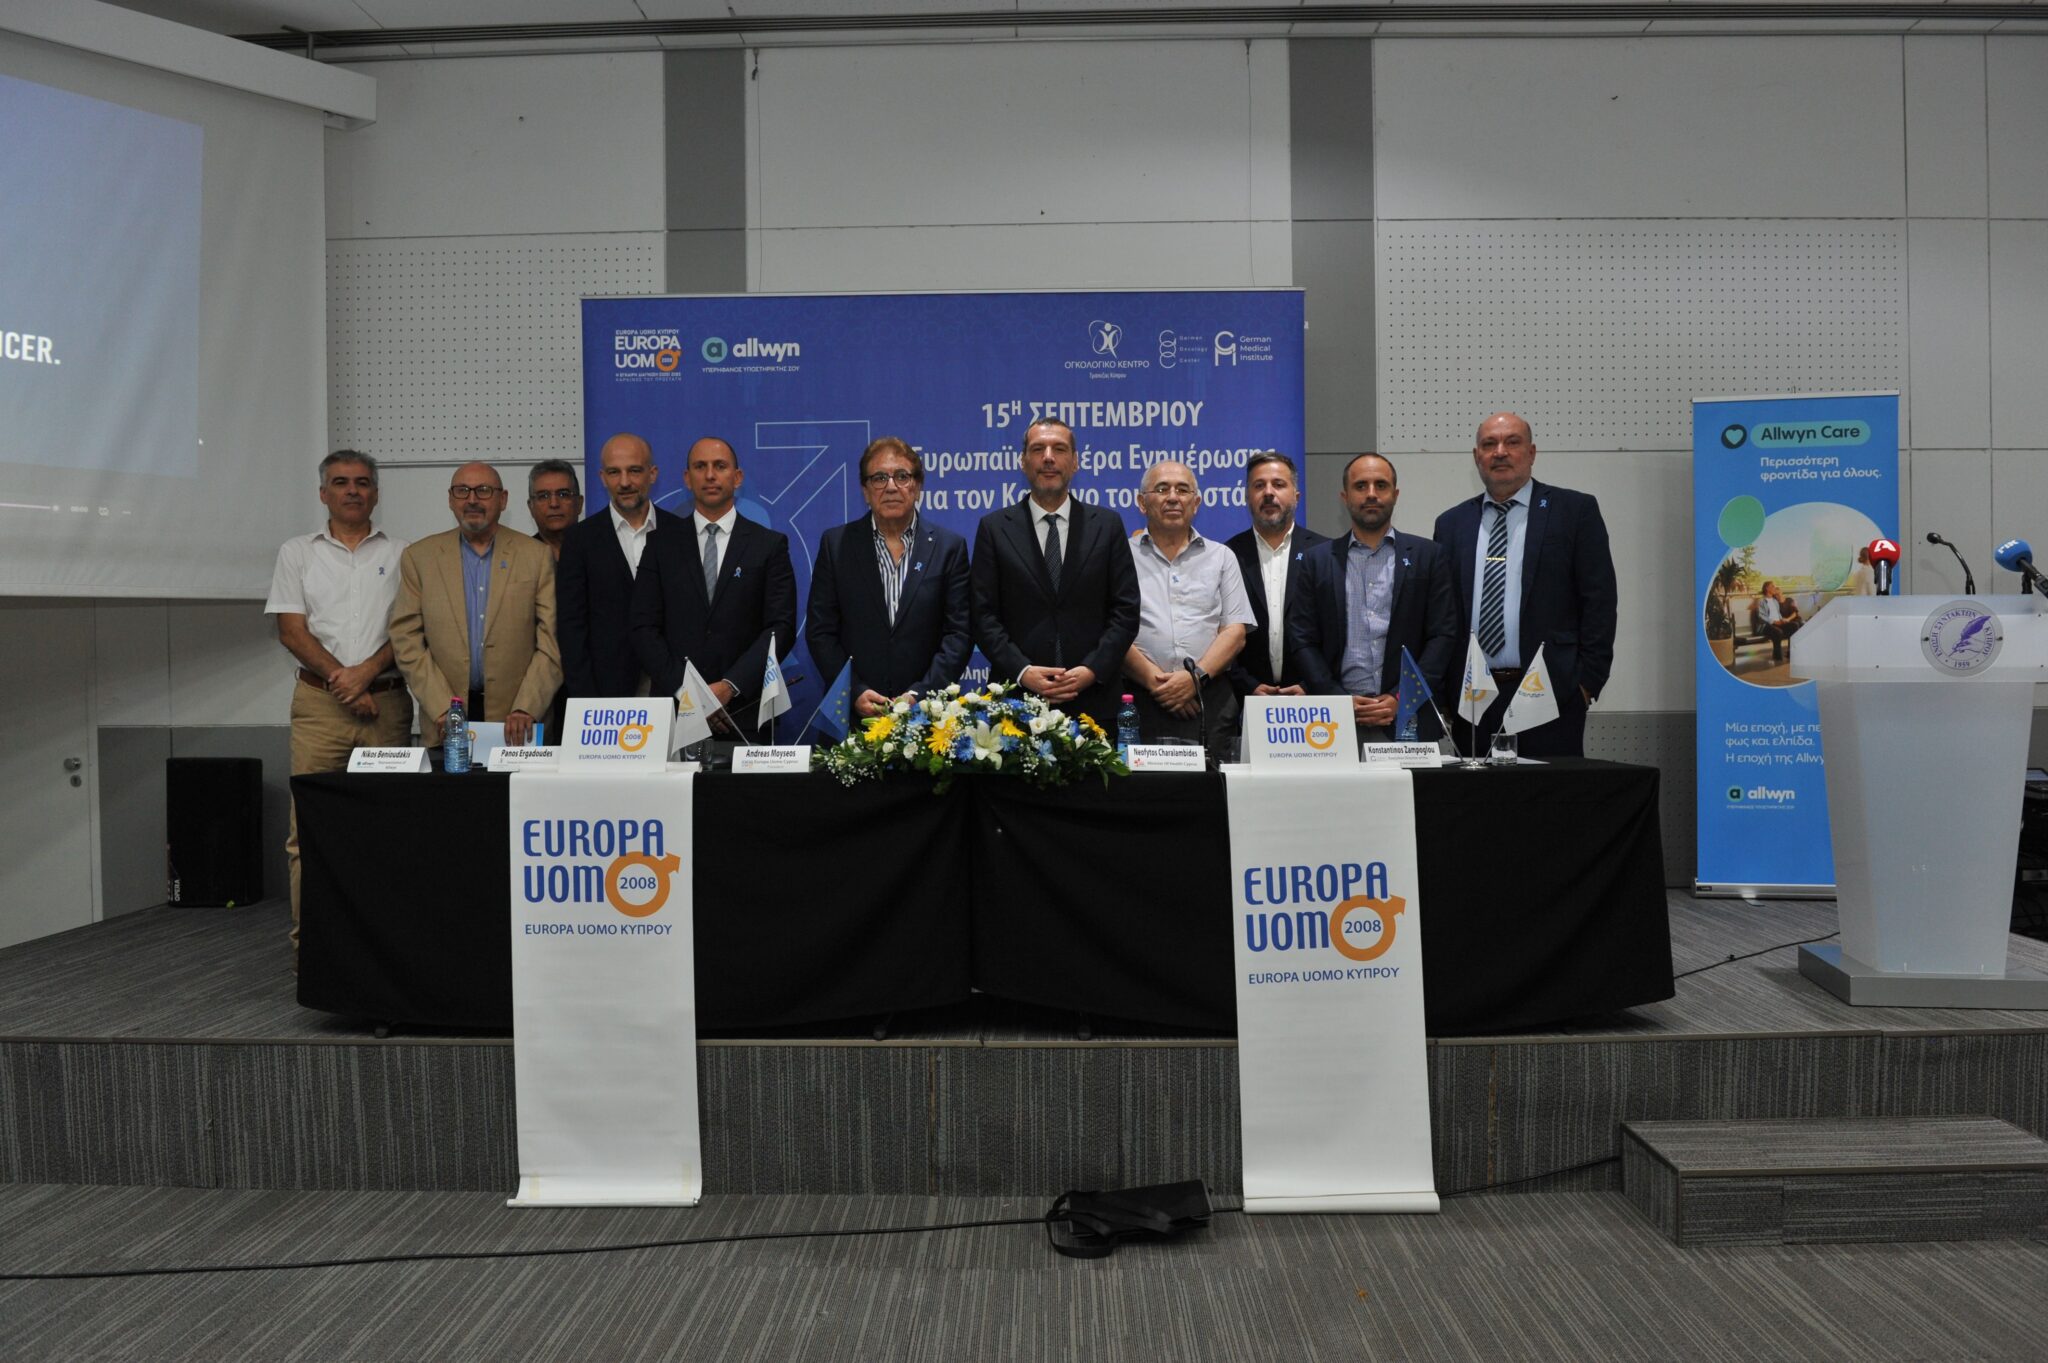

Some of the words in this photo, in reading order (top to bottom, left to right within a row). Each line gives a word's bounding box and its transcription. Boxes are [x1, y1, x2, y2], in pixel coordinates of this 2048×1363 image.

[615, 335, 681, 351] EUROPA
[1240, 335, 1272, 343] German
[0, 330, 61, 365] CER.
[733, 338, 800, 363] allwyn
[1240, 353, 1274, 361] Institute
[1118, 360, 1150, 369] ΚΕΝΤΡΟ
[1029, 400, 1203, 428] ΣΕΠΤΕΜΒΡΙΟΥ
[1761, 427, 1817, 443] Allwyn
[1821, 425, 1860, 438] Care
[911, 445, 1025, 478] υρωπαϊκ
[1076, 444, 1122, 476] έρα
[1760, 456, 1839, 469] Περισσότερη
[1760, 469, 1818, 482] φροντίδα
[1820, 470, 1841, 481] για
[954, 489, 995, 510] τον
[583, 709, 648, 726] EUROPA
[1266, 707, 1331, 724] EUROPA
[1725, 723, 1748, 733] Μία
[1791, 724, 1805, 735] με
[1725, 738, 1750, 748] φως
[1752, 738, 1770, 746] και
[361, 750, 377, 758] Nikos
[501, 749, 519, 758] Panos
[746, 749, 770, 758] Andreas
[1134, 748, 1157, 758] Neofytos
[1158, 748, 1198, 757] Charalambides
[1368, 746, 1403, 754] Konstantinos
[1404, 745, 1435, 756] Zampoglou
[1737, 752, 1772, 766] εποχή
[1775, 754, 1793, 766] της
[1748, 785, 1795, 803] allwyn
[523, 819, 664, 857] EUROPA
[619, 877, 656, 889] 2008
[1244, 862, 1388, 905] EUROPA
[525, 924, 574, 935] EUROPA
[578, 924, 617, 935] UOMO
[620, 924, 673, 935] ΚΥΠΡΟΥ
[1344, 920, 1381, 934] 2008
[1248, 972, 1299, 984] EUROPA
[1302, 969, 1343, 982] UOMO
[1346, 967, 1400, 980] ΚΥΠΡΟΥ
